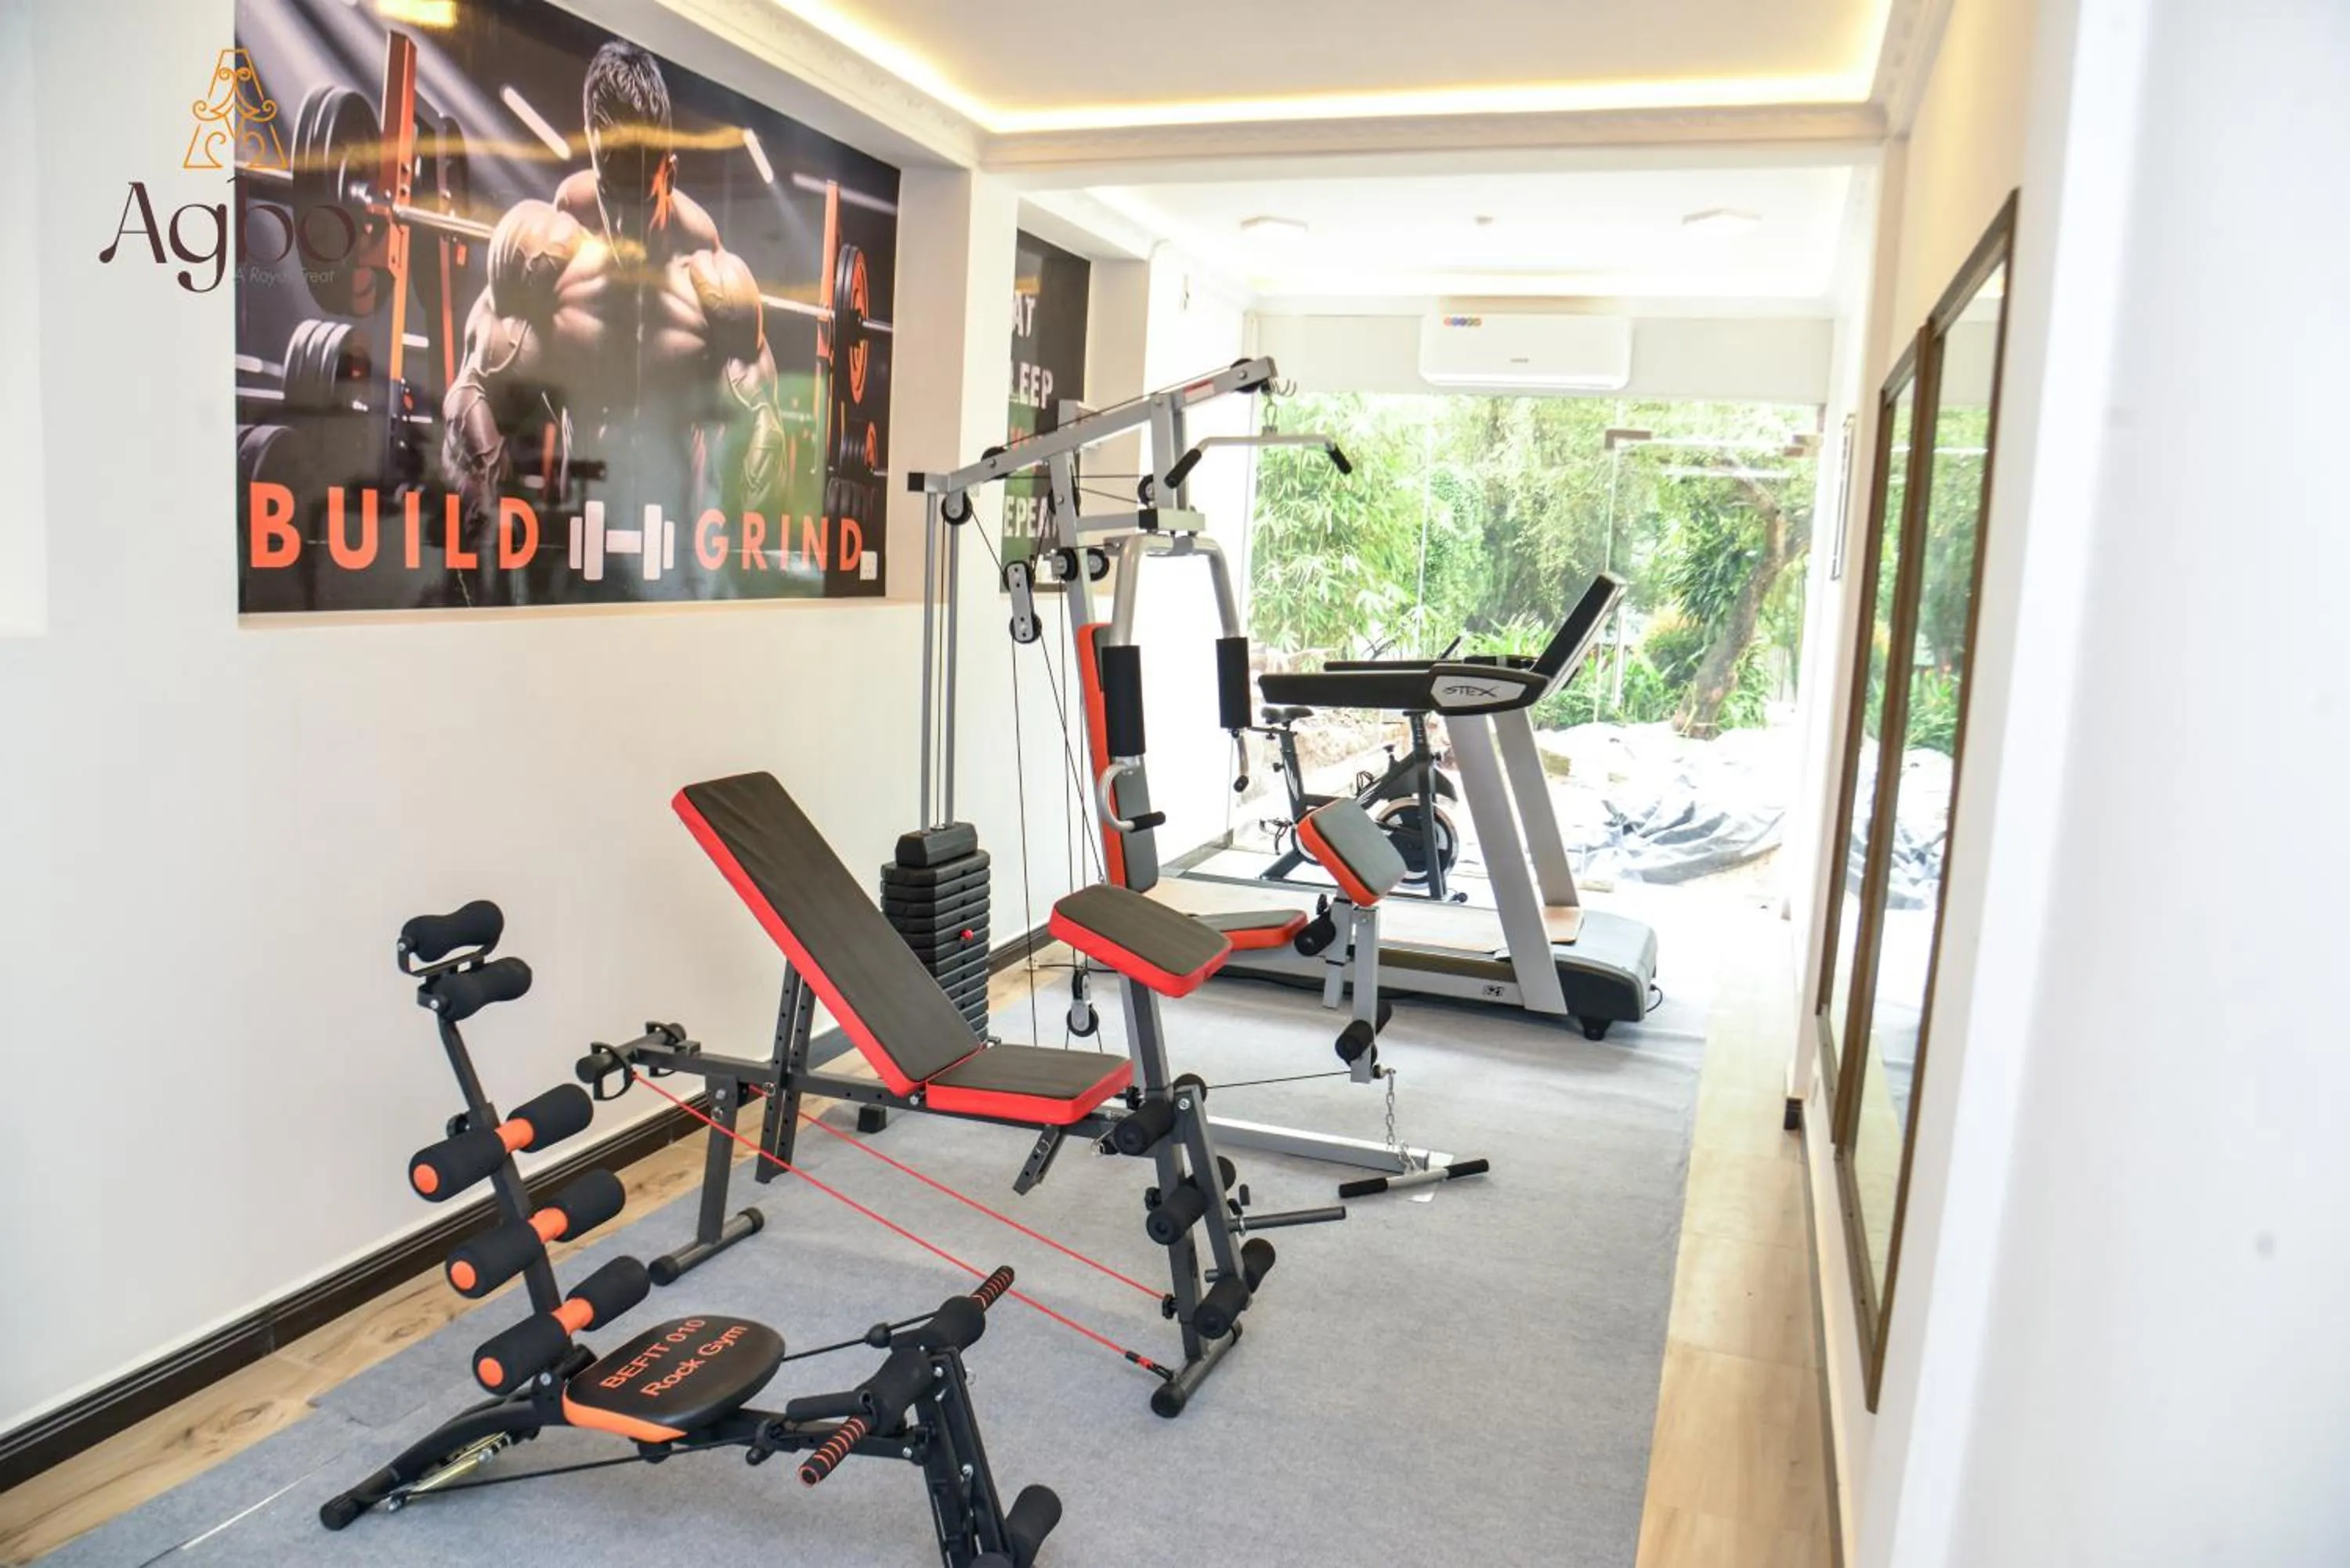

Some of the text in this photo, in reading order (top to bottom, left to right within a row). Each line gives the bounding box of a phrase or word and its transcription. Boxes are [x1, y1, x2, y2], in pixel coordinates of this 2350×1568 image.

[250, 482, 863, 571] BUILD GRIND
[1444, 685, 1500, 698] STEX
[599, 1319, 706, 1389] BEFIT 010
[640, 1326, 749, 1396] Rock Gym
